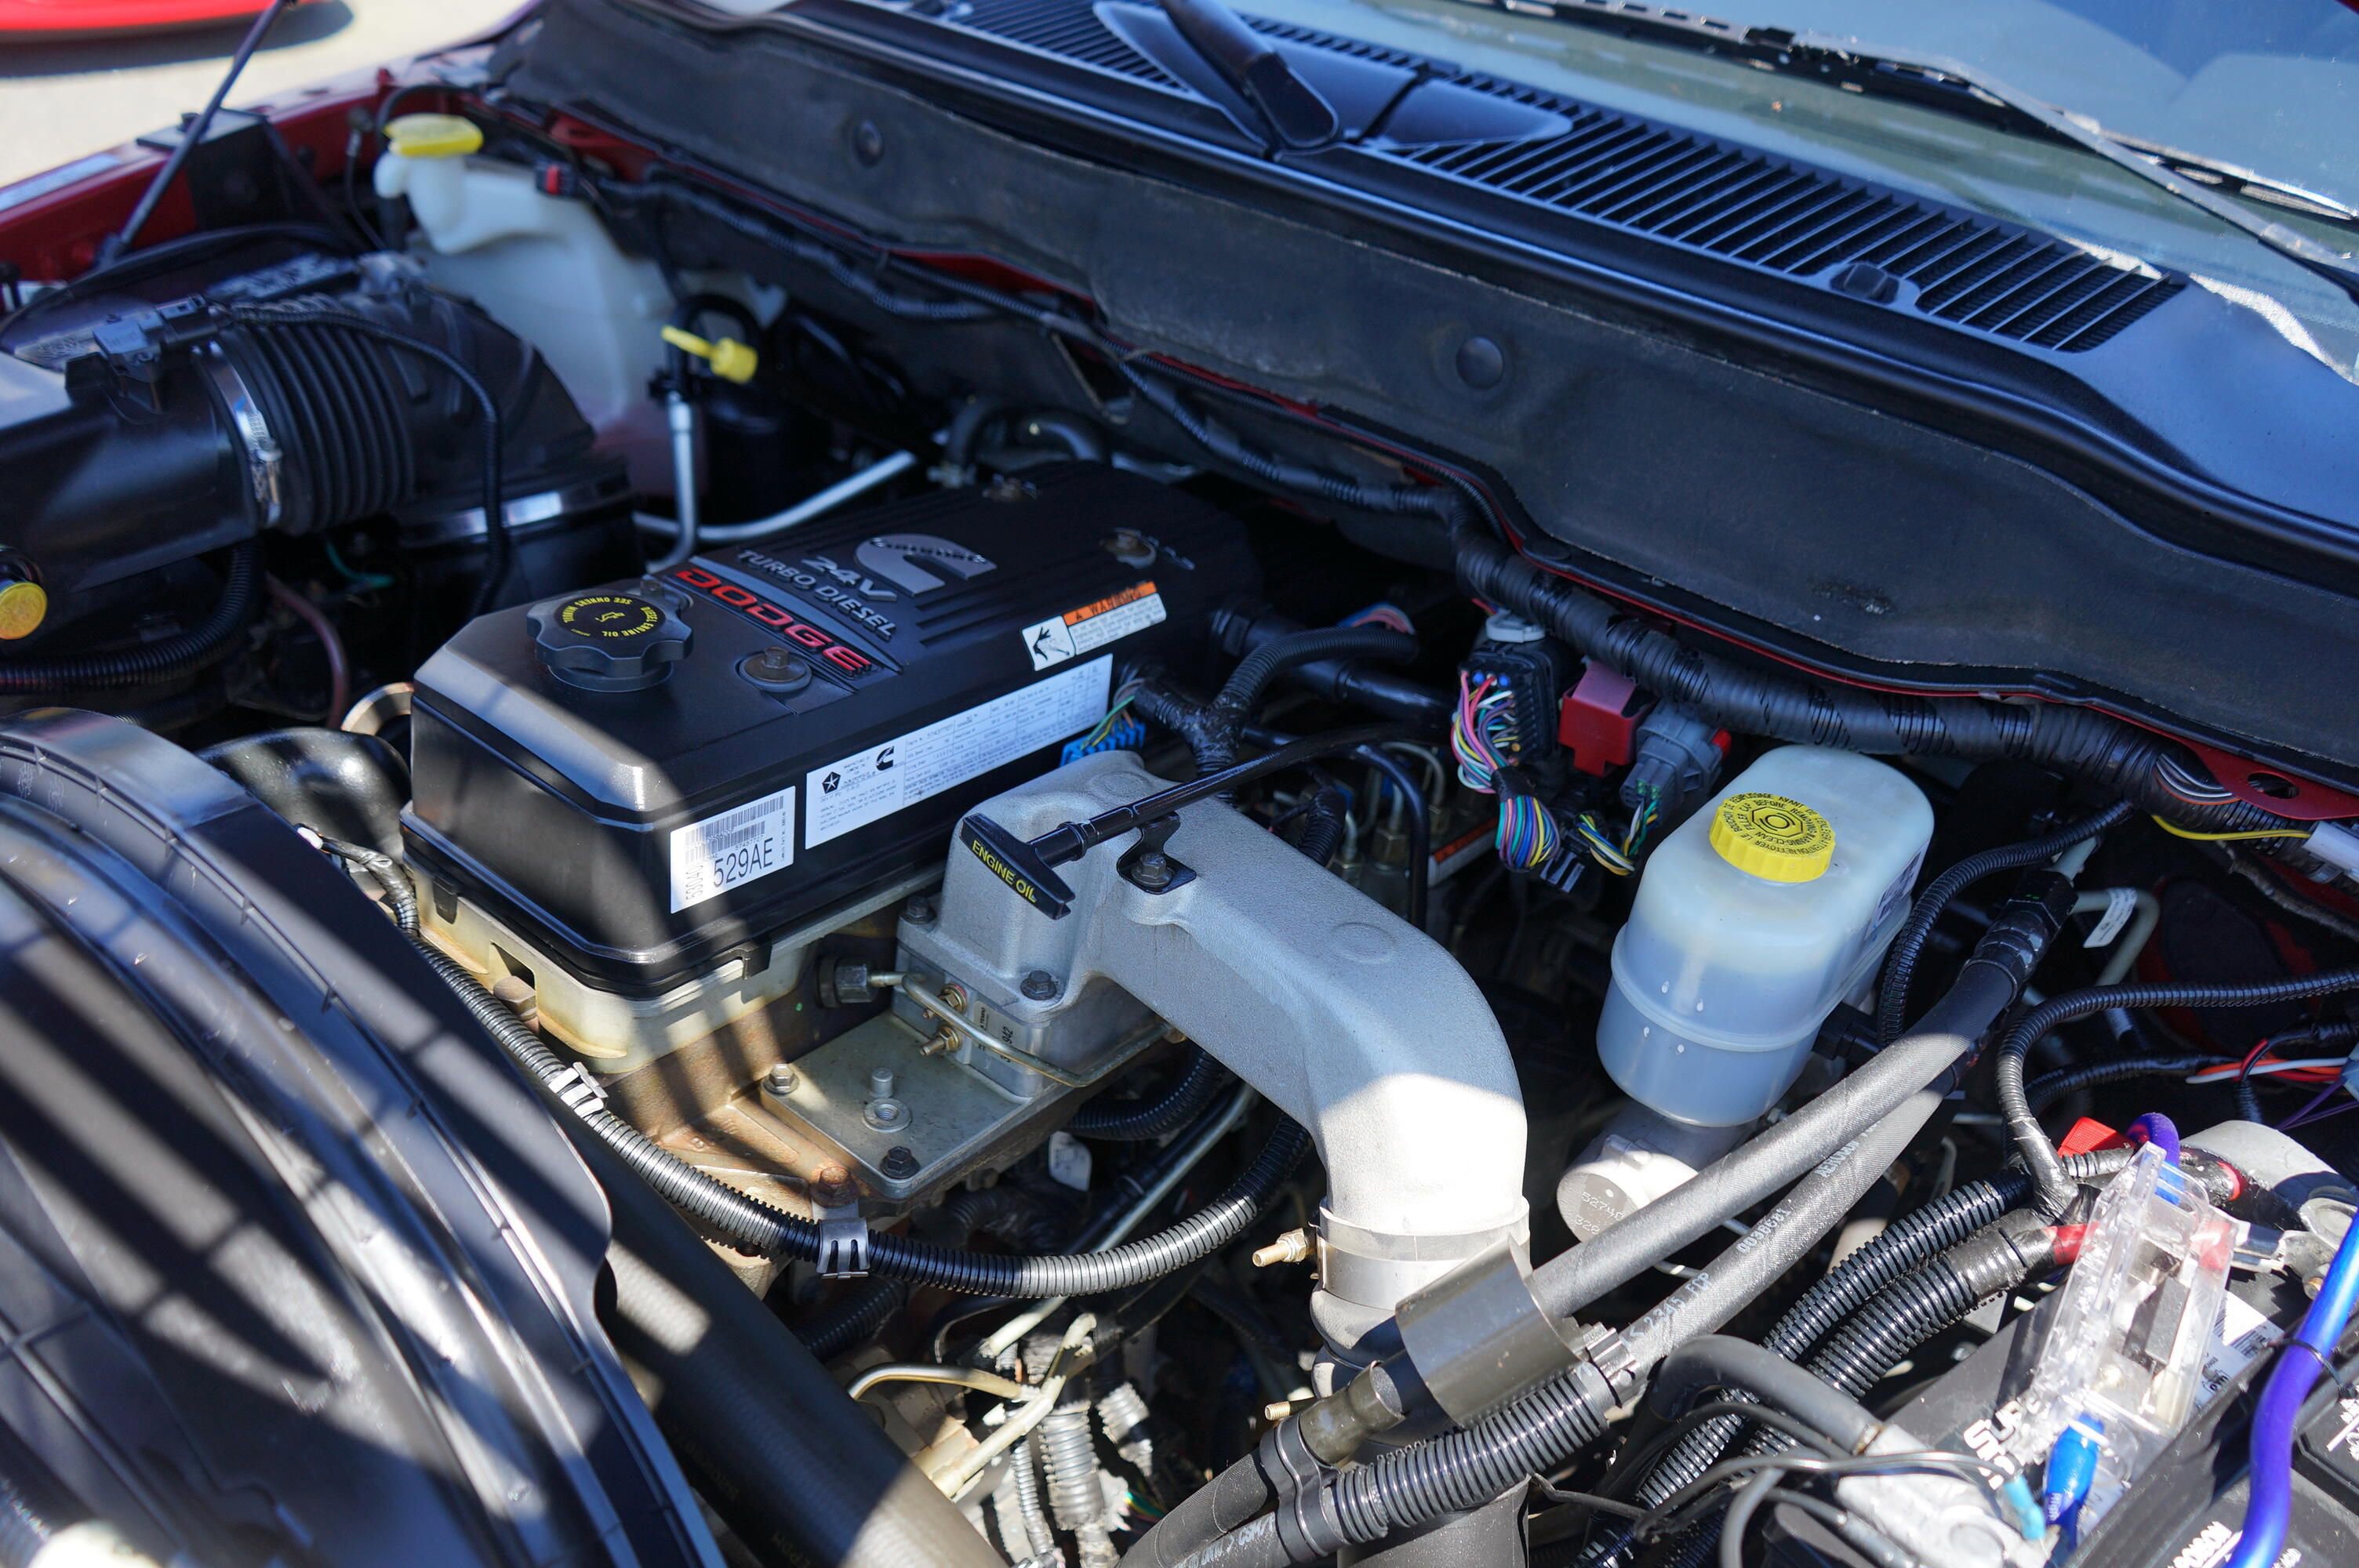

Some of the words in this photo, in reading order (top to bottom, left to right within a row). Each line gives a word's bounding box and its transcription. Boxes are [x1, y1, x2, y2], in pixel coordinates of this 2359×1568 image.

[613, 597, 633, 605] SEE
[739, 549, 817, 591] TURBO
[815, 584, 898, 642] DIESEL
[801, 555, 898, 602] 24V
[621, 622, 655, 637] ENGINE
[676, 568, 874, 673] DODGE
[1753, 800, 1787, 809] BEFORE
[1779, 796, 1805, 808] AVANT
[713, 837, 774, 888] 529AE
[972, 840, 1016, 885] ENGINE
[1015, 880, 1037, 903] OIL
